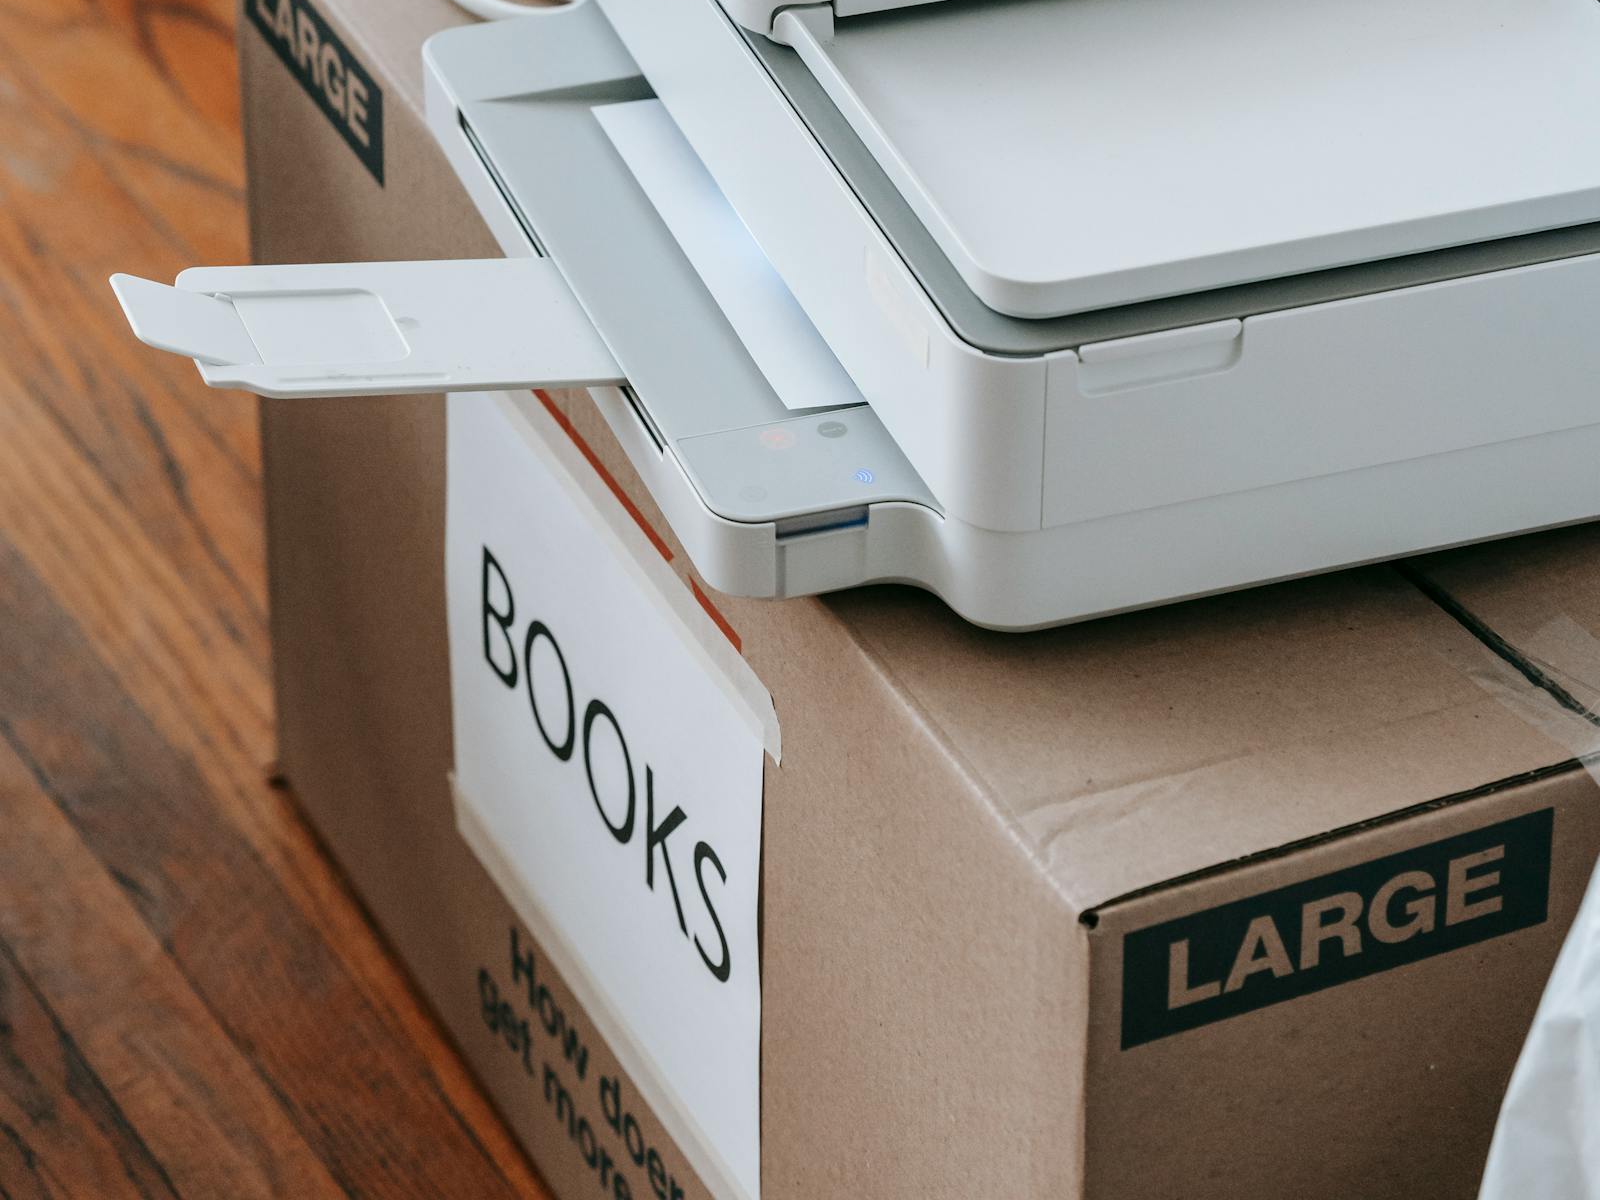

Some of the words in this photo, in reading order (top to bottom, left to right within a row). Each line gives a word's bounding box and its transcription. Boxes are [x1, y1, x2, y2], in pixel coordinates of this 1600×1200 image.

[482, 544, 732, 983] BOOKS
[510, 926, 589, 1082] How
[1167, 844, 1506, 1011] LARGE
[477, 966, 535, 1078] get
